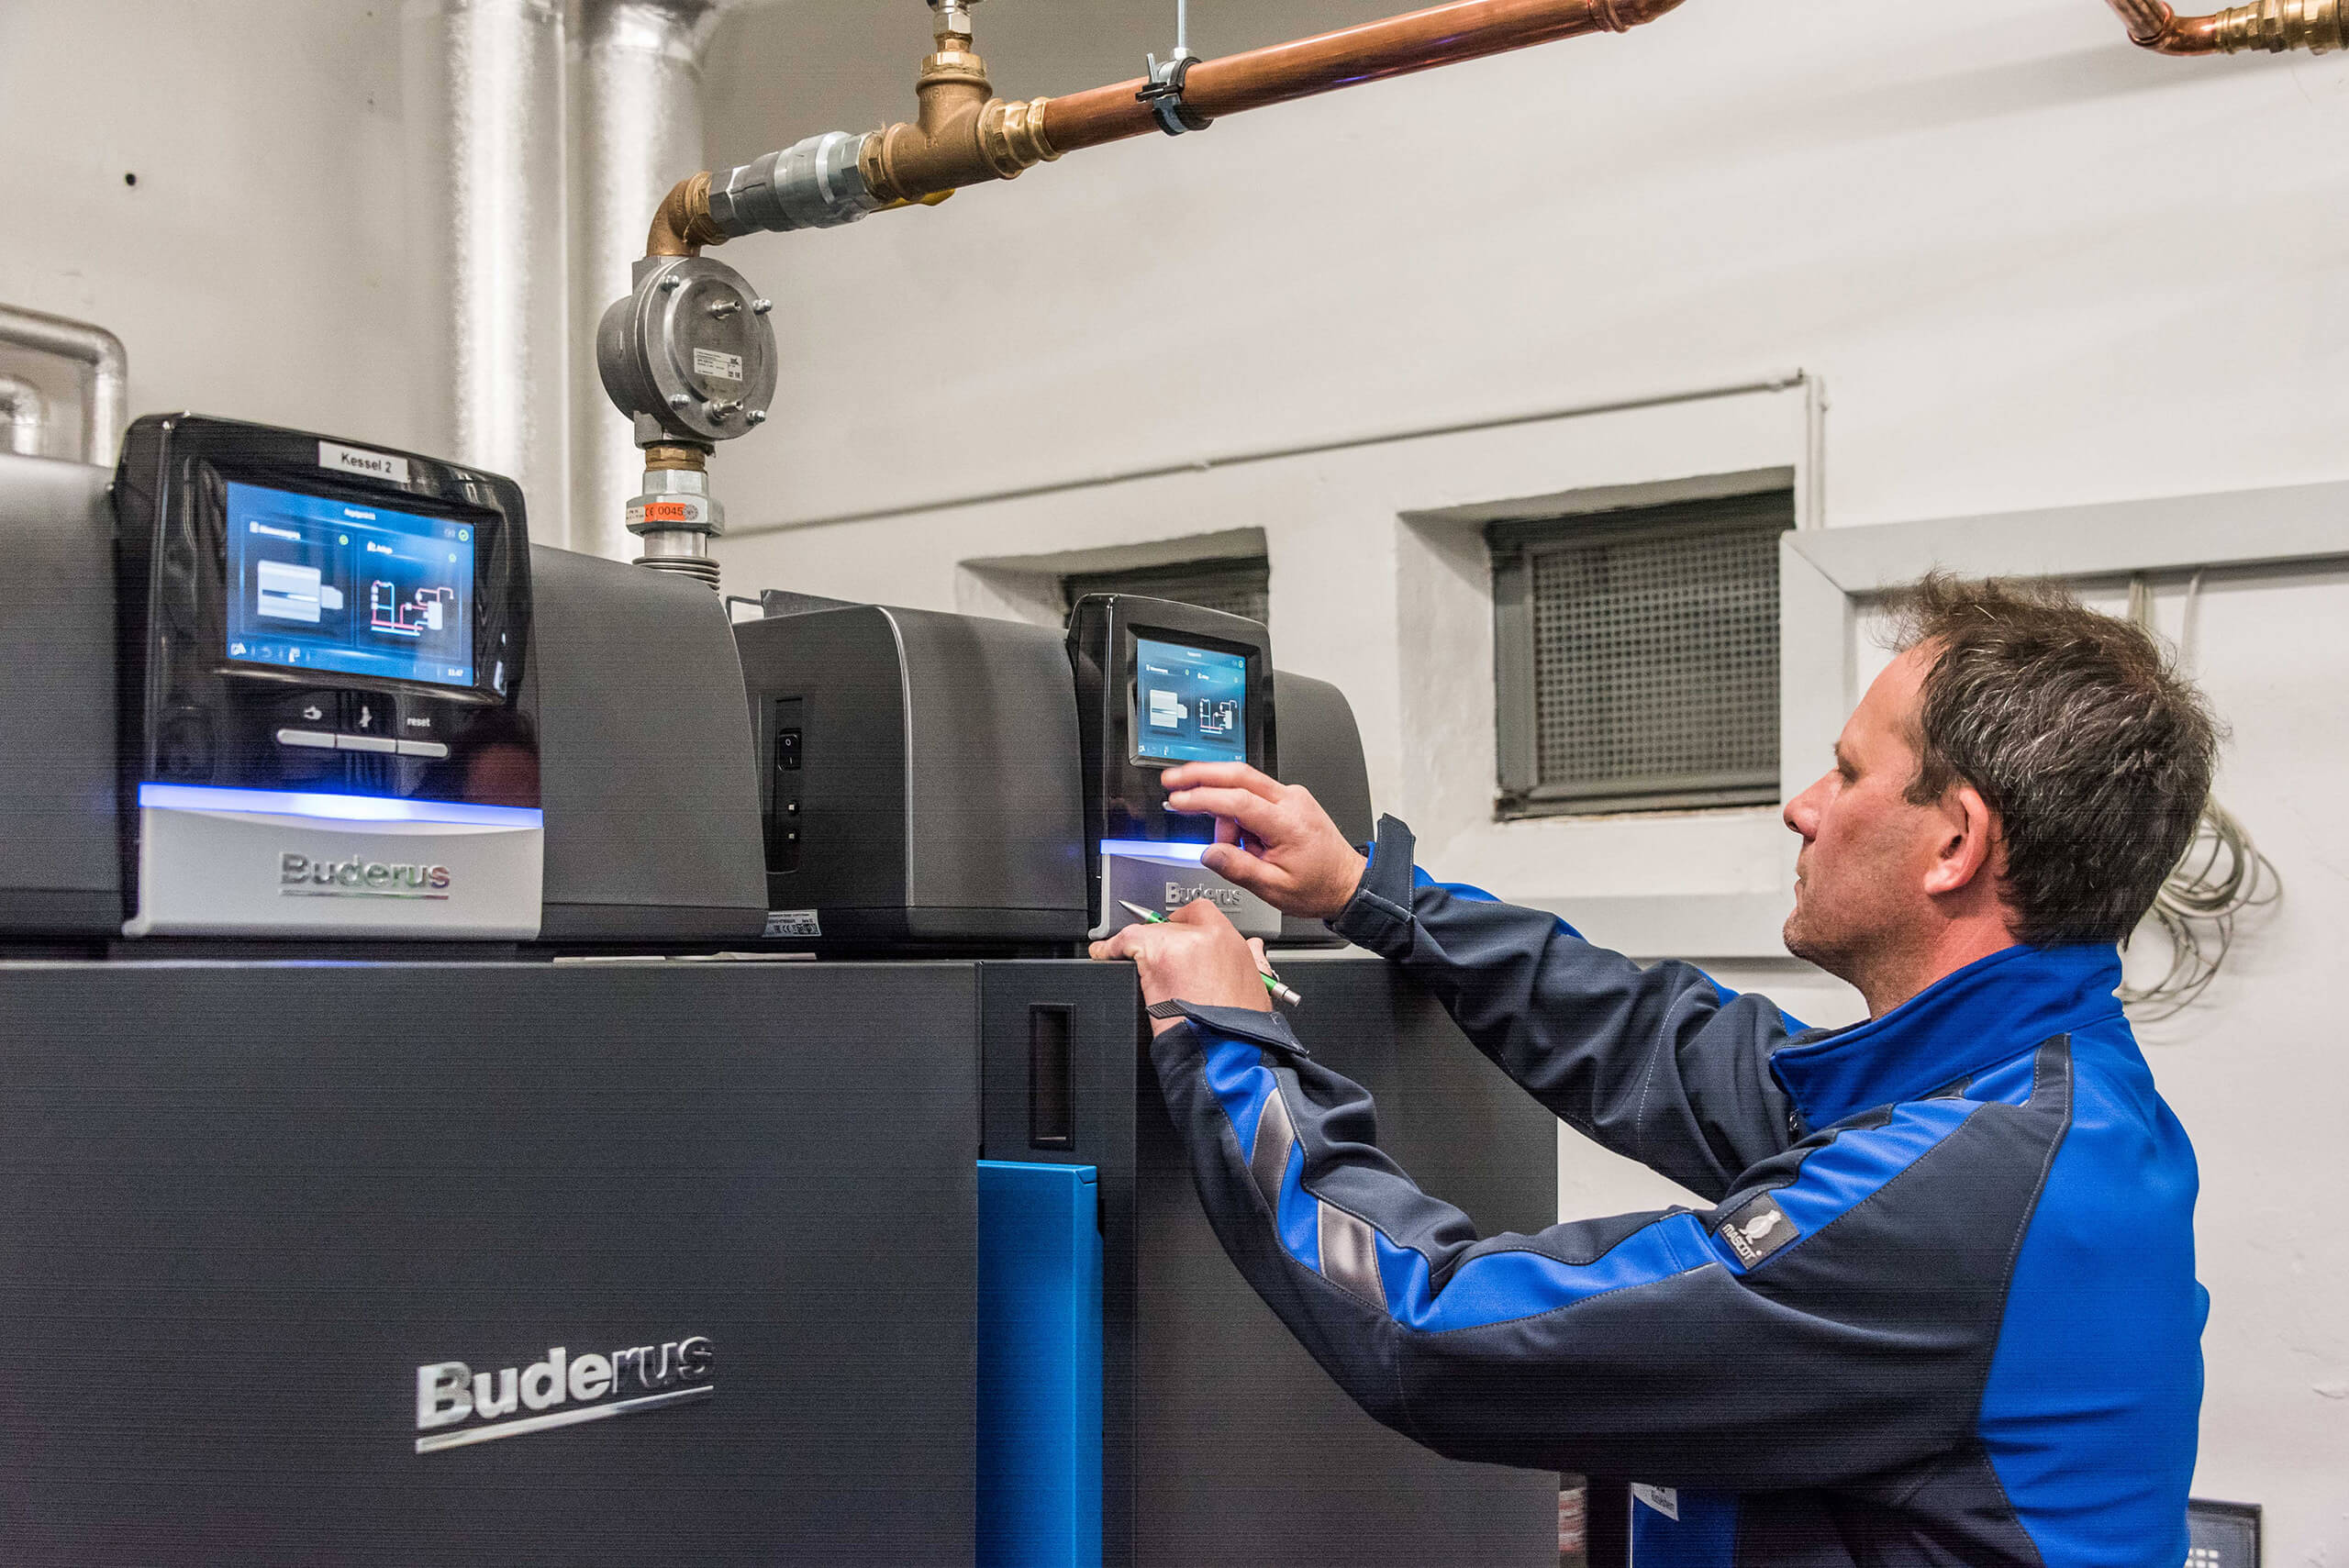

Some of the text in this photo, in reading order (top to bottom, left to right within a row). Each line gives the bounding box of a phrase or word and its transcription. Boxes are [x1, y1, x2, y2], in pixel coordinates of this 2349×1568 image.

[340, 452, 392, 473] Kessel 2
[657, 506, 684, 516] 0045
[406, 717, 430, 727] reset
[279, 851, 451, 889] Buderus
[1165, 882, 1241, 905] Buderus
[1721, 1223, 1757, 1261] MASCOT
[416, 1336, 713, 1429] Buderus
